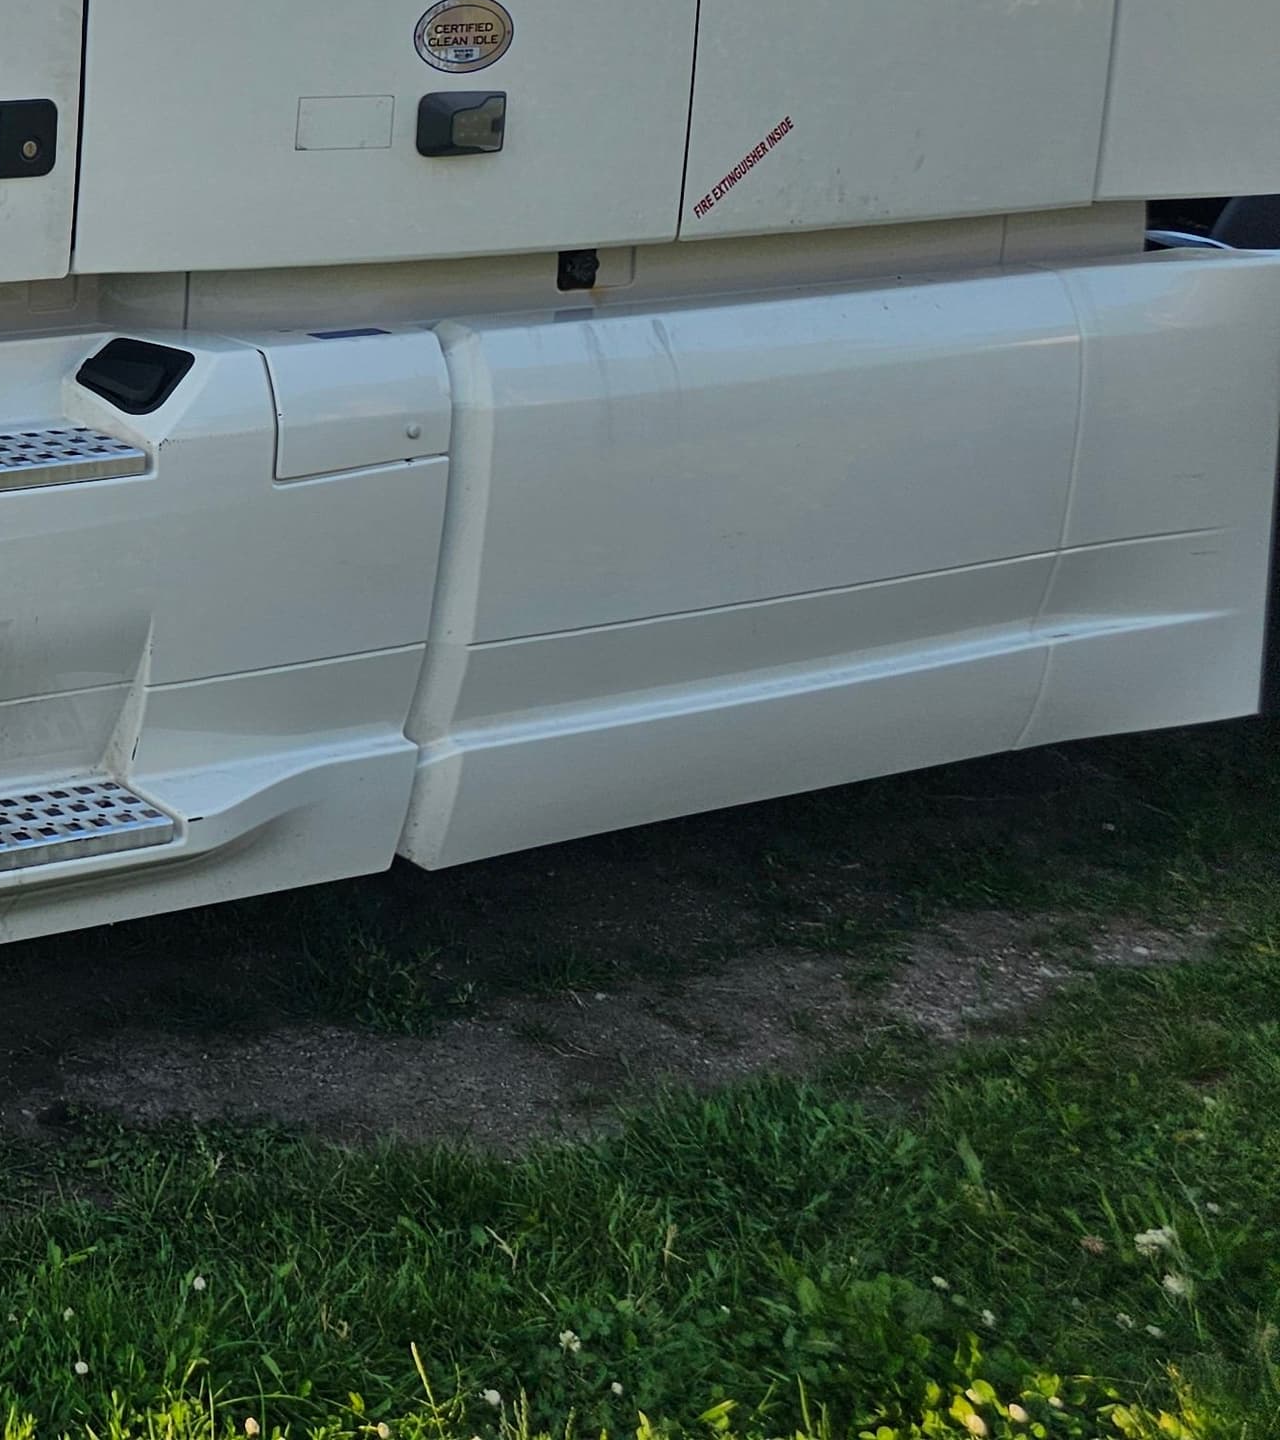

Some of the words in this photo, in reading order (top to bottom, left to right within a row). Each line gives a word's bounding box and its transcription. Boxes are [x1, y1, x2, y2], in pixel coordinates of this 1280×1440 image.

[434, 22, 494, 34] CERTIFIED
[428, 36, 468, 47] CLEAN
[473, 34, 498, 45] IDLE
[693, 194, 714, 219] FIRE
[711, 141, 769, 201] EXTINGUISHER
[766, 116, 794, 148] INSIDE
